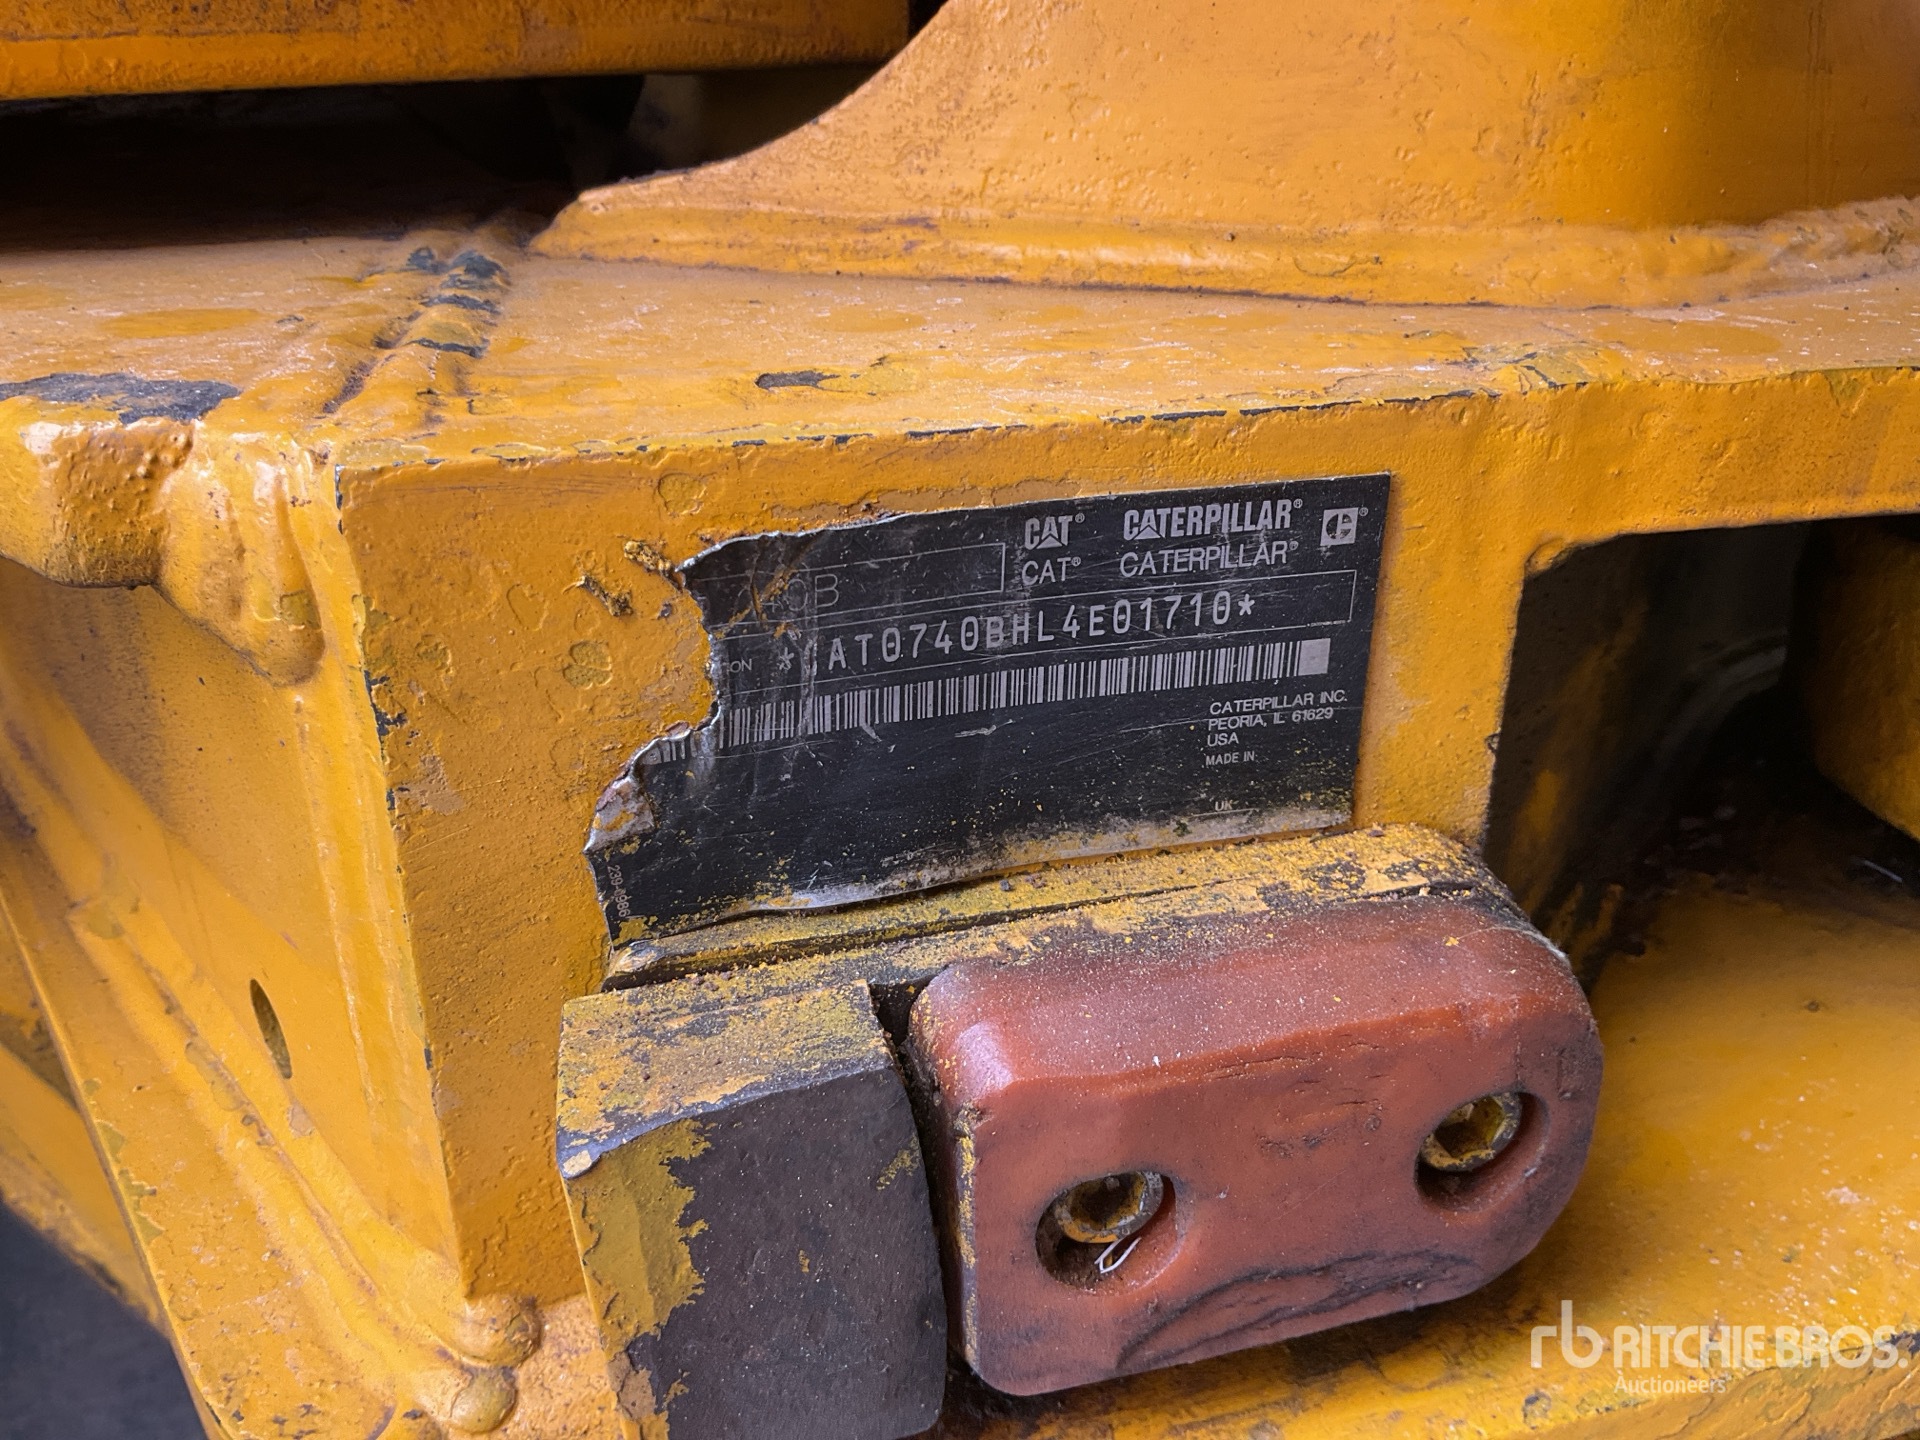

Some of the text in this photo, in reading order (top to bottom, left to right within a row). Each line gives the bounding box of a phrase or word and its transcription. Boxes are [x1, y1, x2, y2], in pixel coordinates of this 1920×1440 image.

[778, 590, 1256, 673] AT0740BHL4E01710
[1210, 689, 1348, 715] CATERPILLAR INC.
[1208, 707, 1334, 731] PEORIA, IL 61629
[1207, 732, 1239, 747] USA
[1205, 752, 1239, 767] MADE
